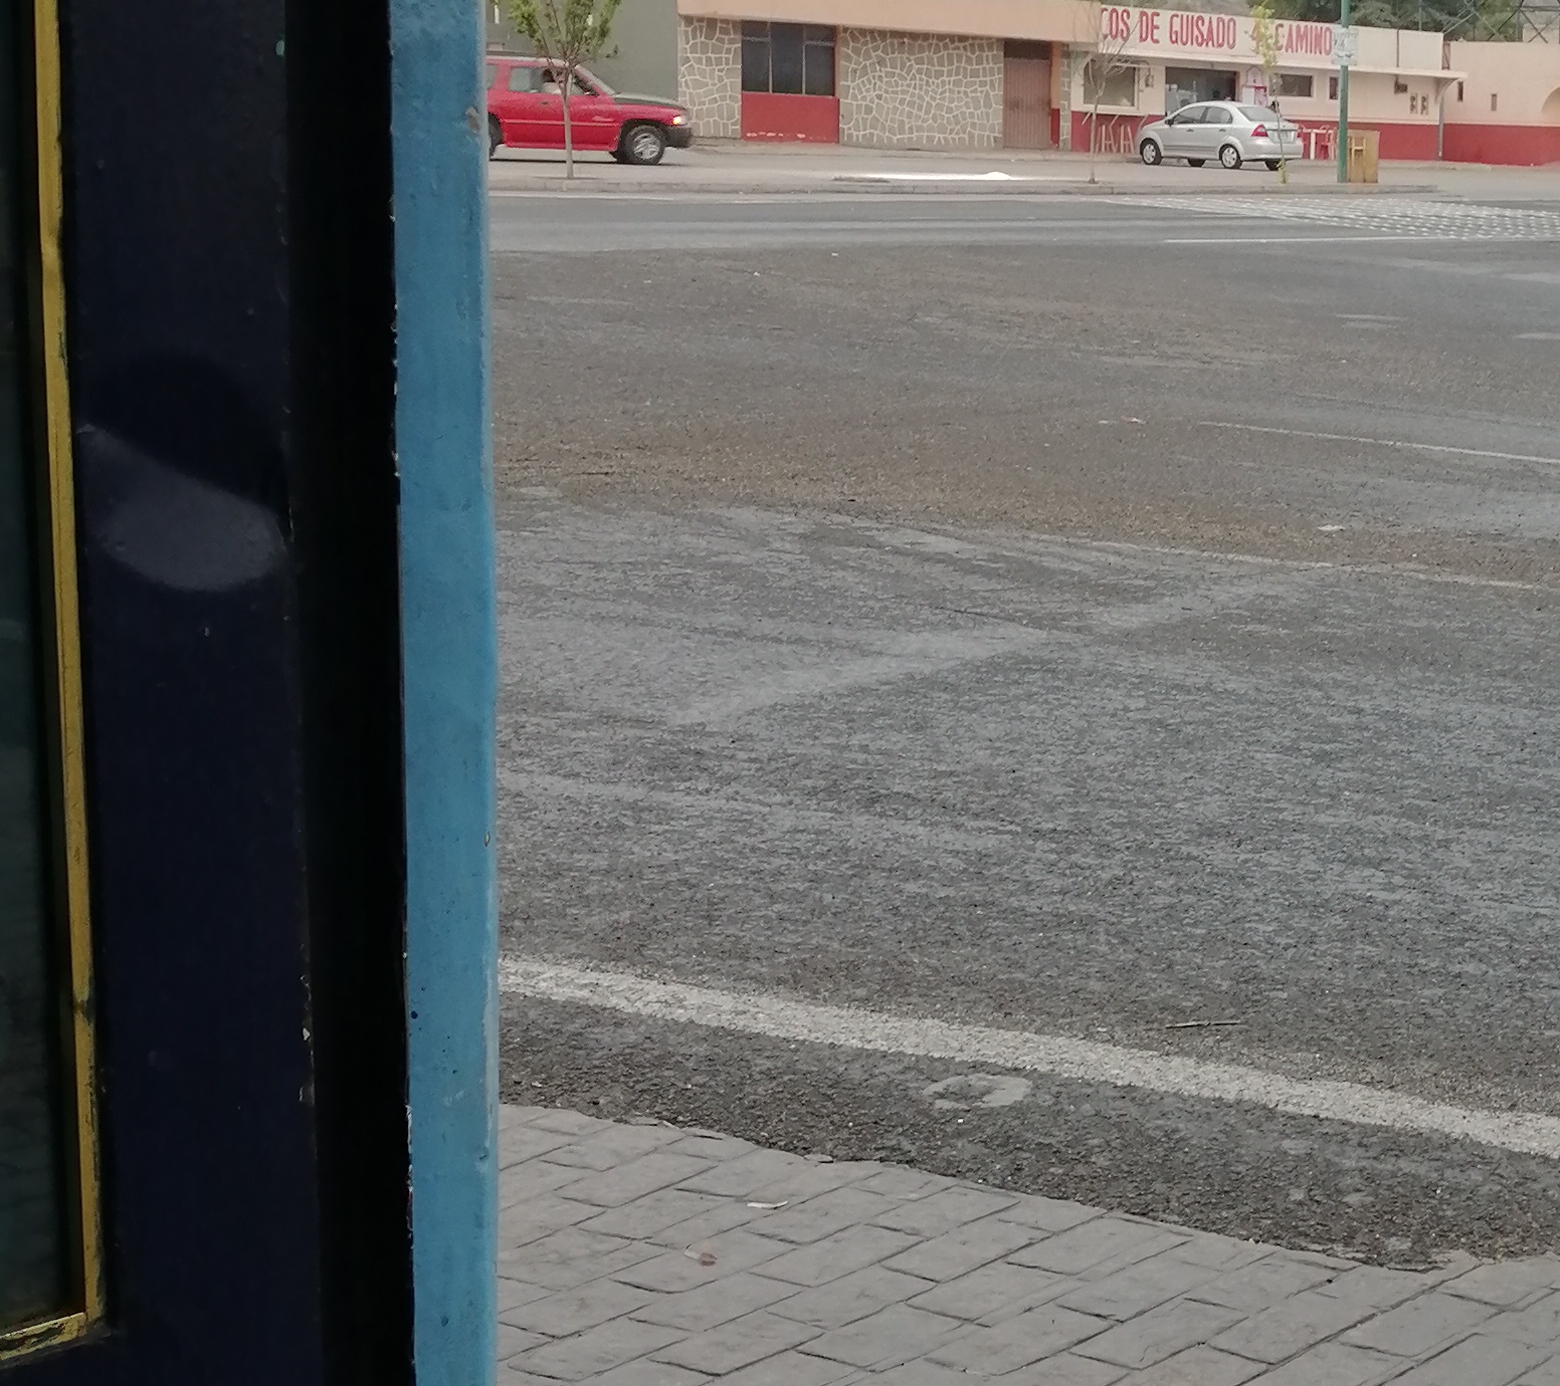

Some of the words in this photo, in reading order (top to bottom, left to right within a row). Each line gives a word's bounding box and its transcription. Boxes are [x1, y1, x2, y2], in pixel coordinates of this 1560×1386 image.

[1139, 10, 1160, 44] DE
[1169, 13, 1237, 50] GUISADO
[1275, 23, 1332, 55] CAMINO
